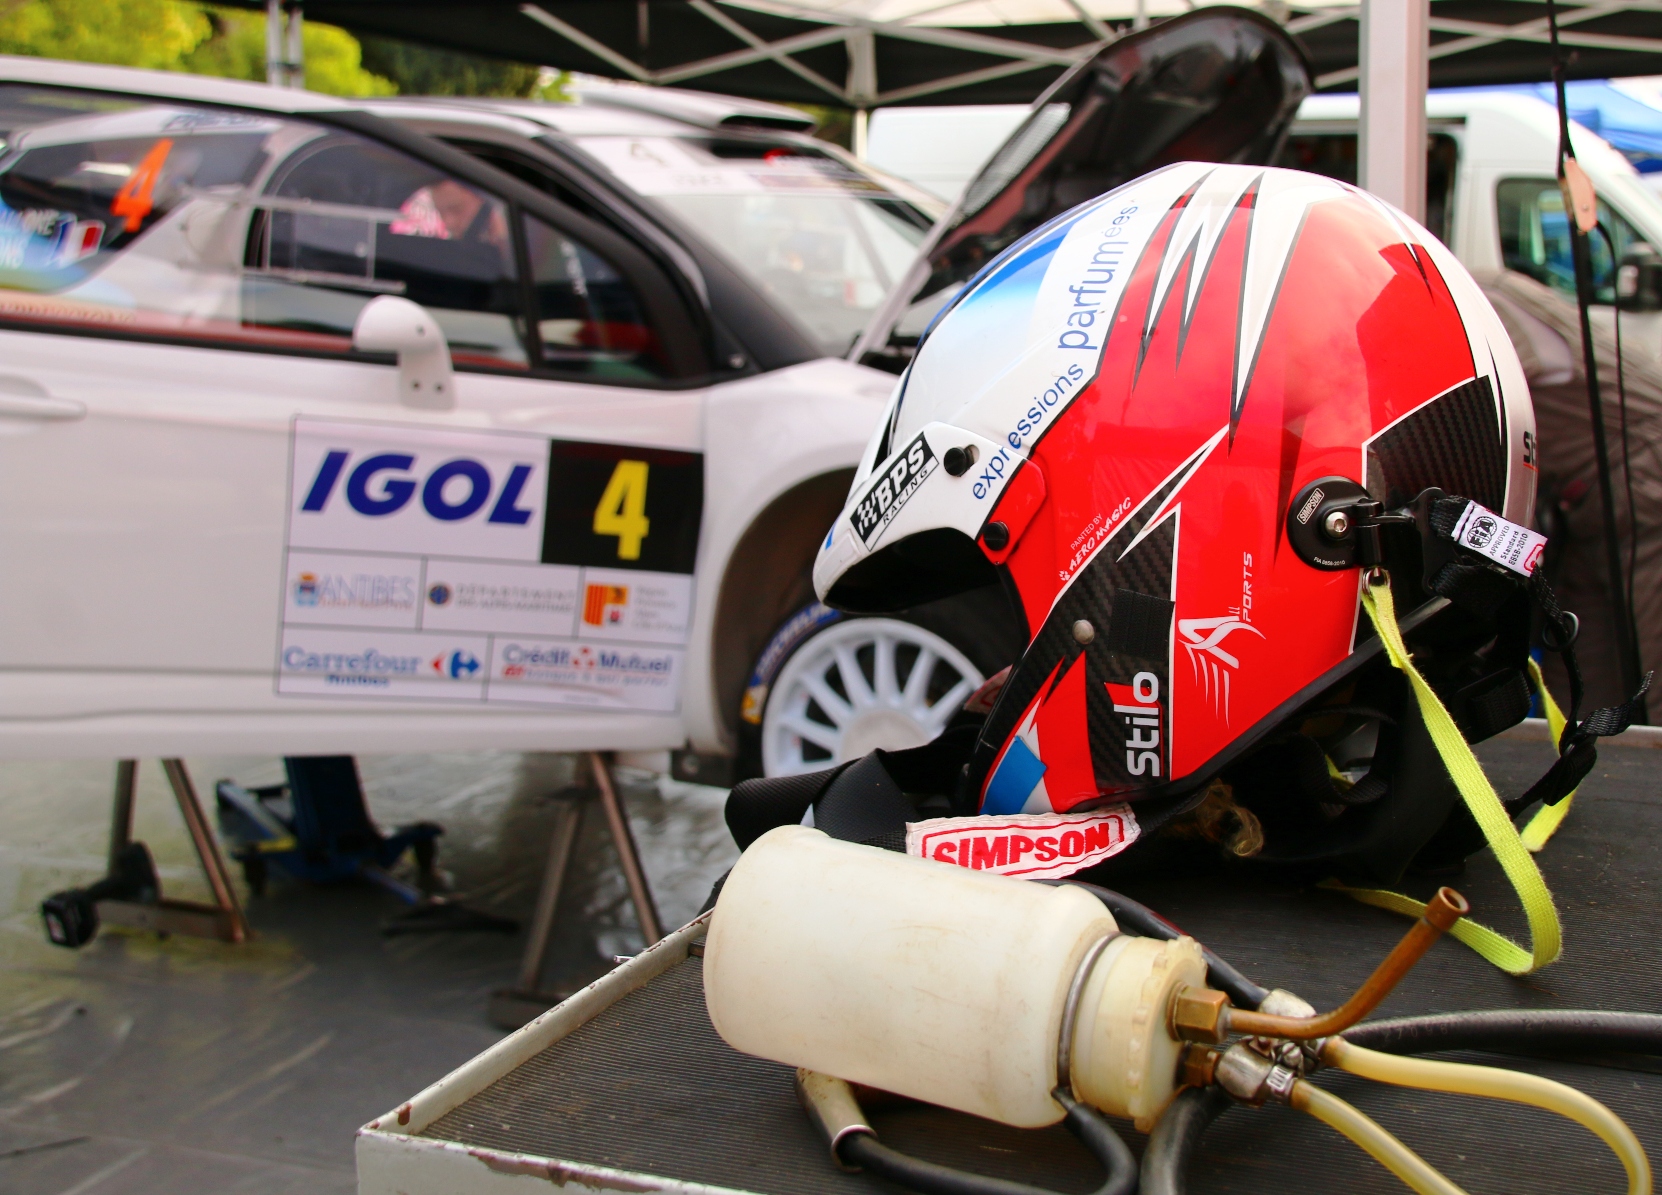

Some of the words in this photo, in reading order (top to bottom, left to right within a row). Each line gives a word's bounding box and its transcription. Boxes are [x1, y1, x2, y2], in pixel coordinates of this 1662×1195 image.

[110, 137, 174, 233] 4
[973, 363, 1084, 501] expressions
[301, 450, 535, 526] IGOL
[874, 439, 925, 515] BPS
[881, 465, 928, 525] RACING
[592, 459, 650, 560] 4
[1300, 490, 1322, 521] SIMPSON
[1069, 537, 1096, 571] AERO
[1095, 496, 1131, 541] MAGIC
[1070, 523, 1095, 551] PAINTED
[1092, 512, 1103, 525] BY
[1489, 525, 1510, 556] APPROVED
[1500, 530, 1519, 560] Standard
[1508, 533, 1528, 566] 8858-2010
[1313, 556, 1322, 564] FIA
[283, 645, 422, 673] Carrefour
[933, 822, 1110, 871] SIMPSON
